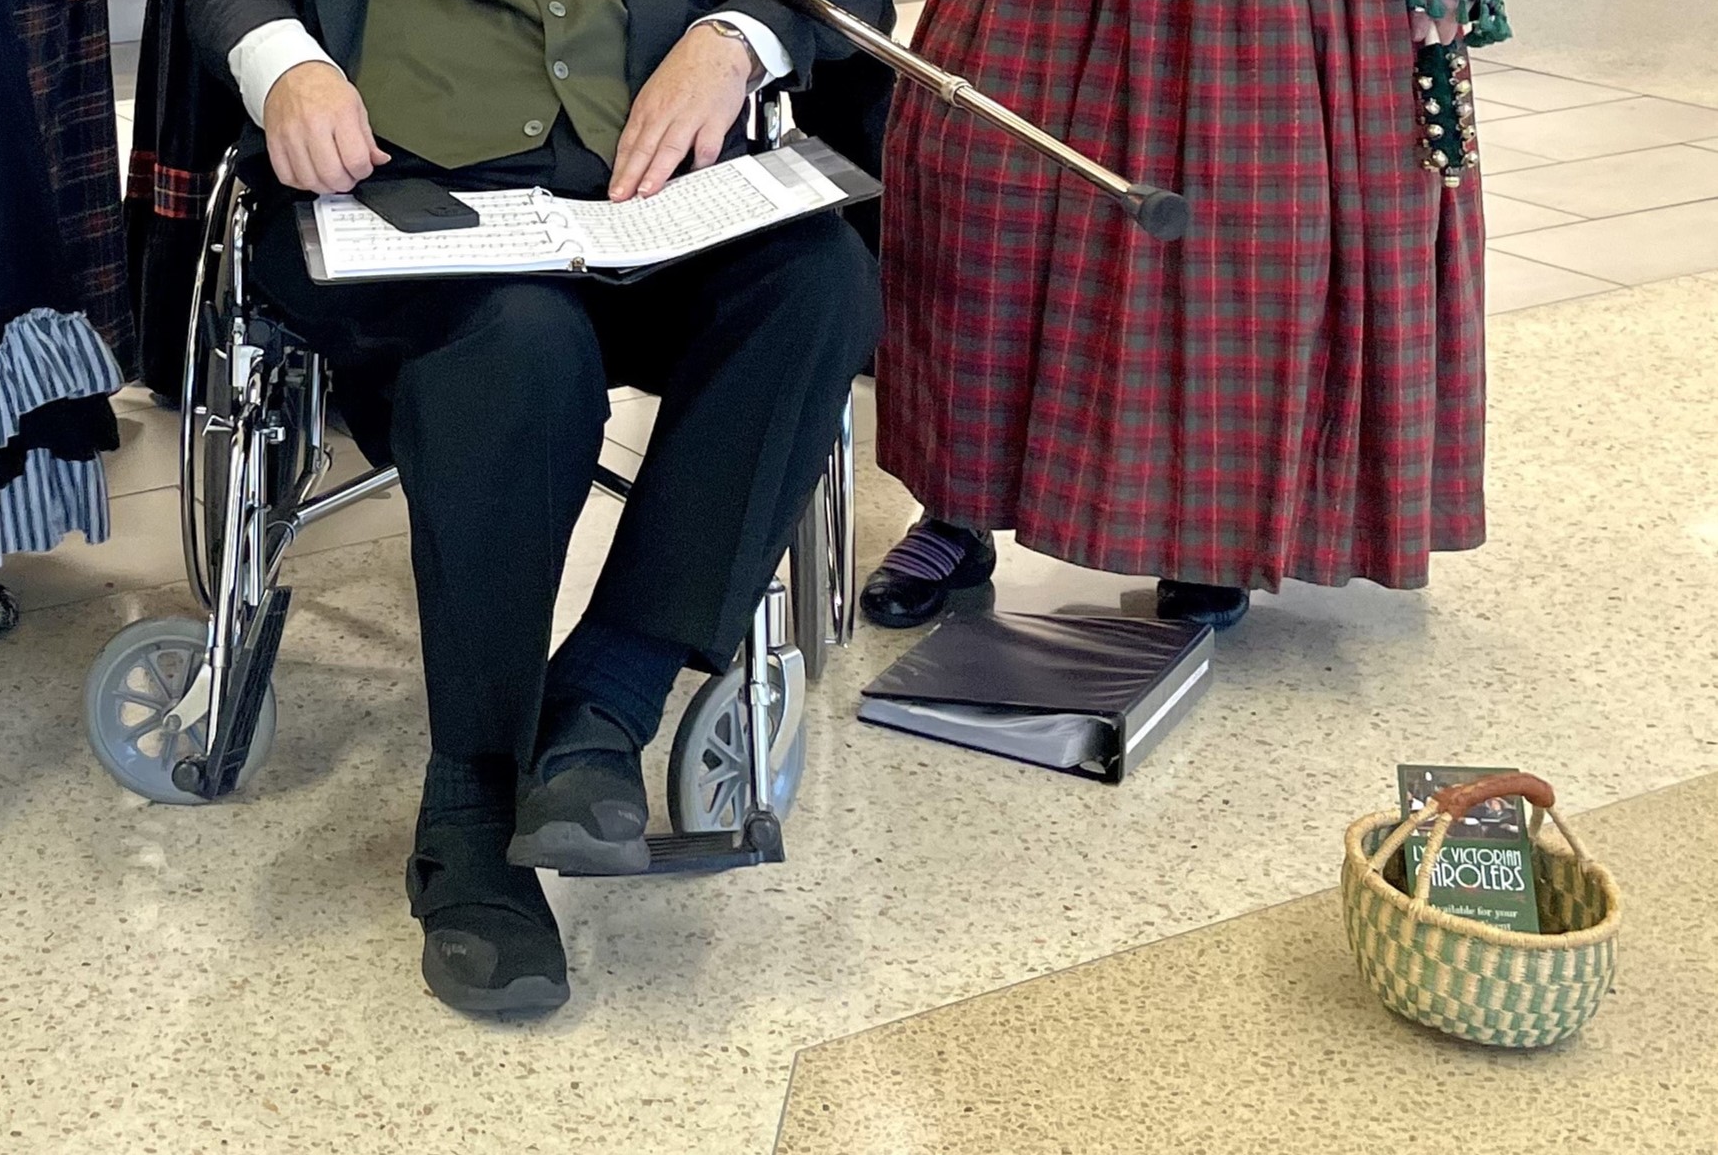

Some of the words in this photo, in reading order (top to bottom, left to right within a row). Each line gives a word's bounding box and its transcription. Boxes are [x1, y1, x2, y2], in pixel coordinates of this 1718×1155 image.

[1451, 847, 1521, 866] VICTORIAN
[1477, 906, 1492, 917] for
[1495, 910, 1518, 919] your
